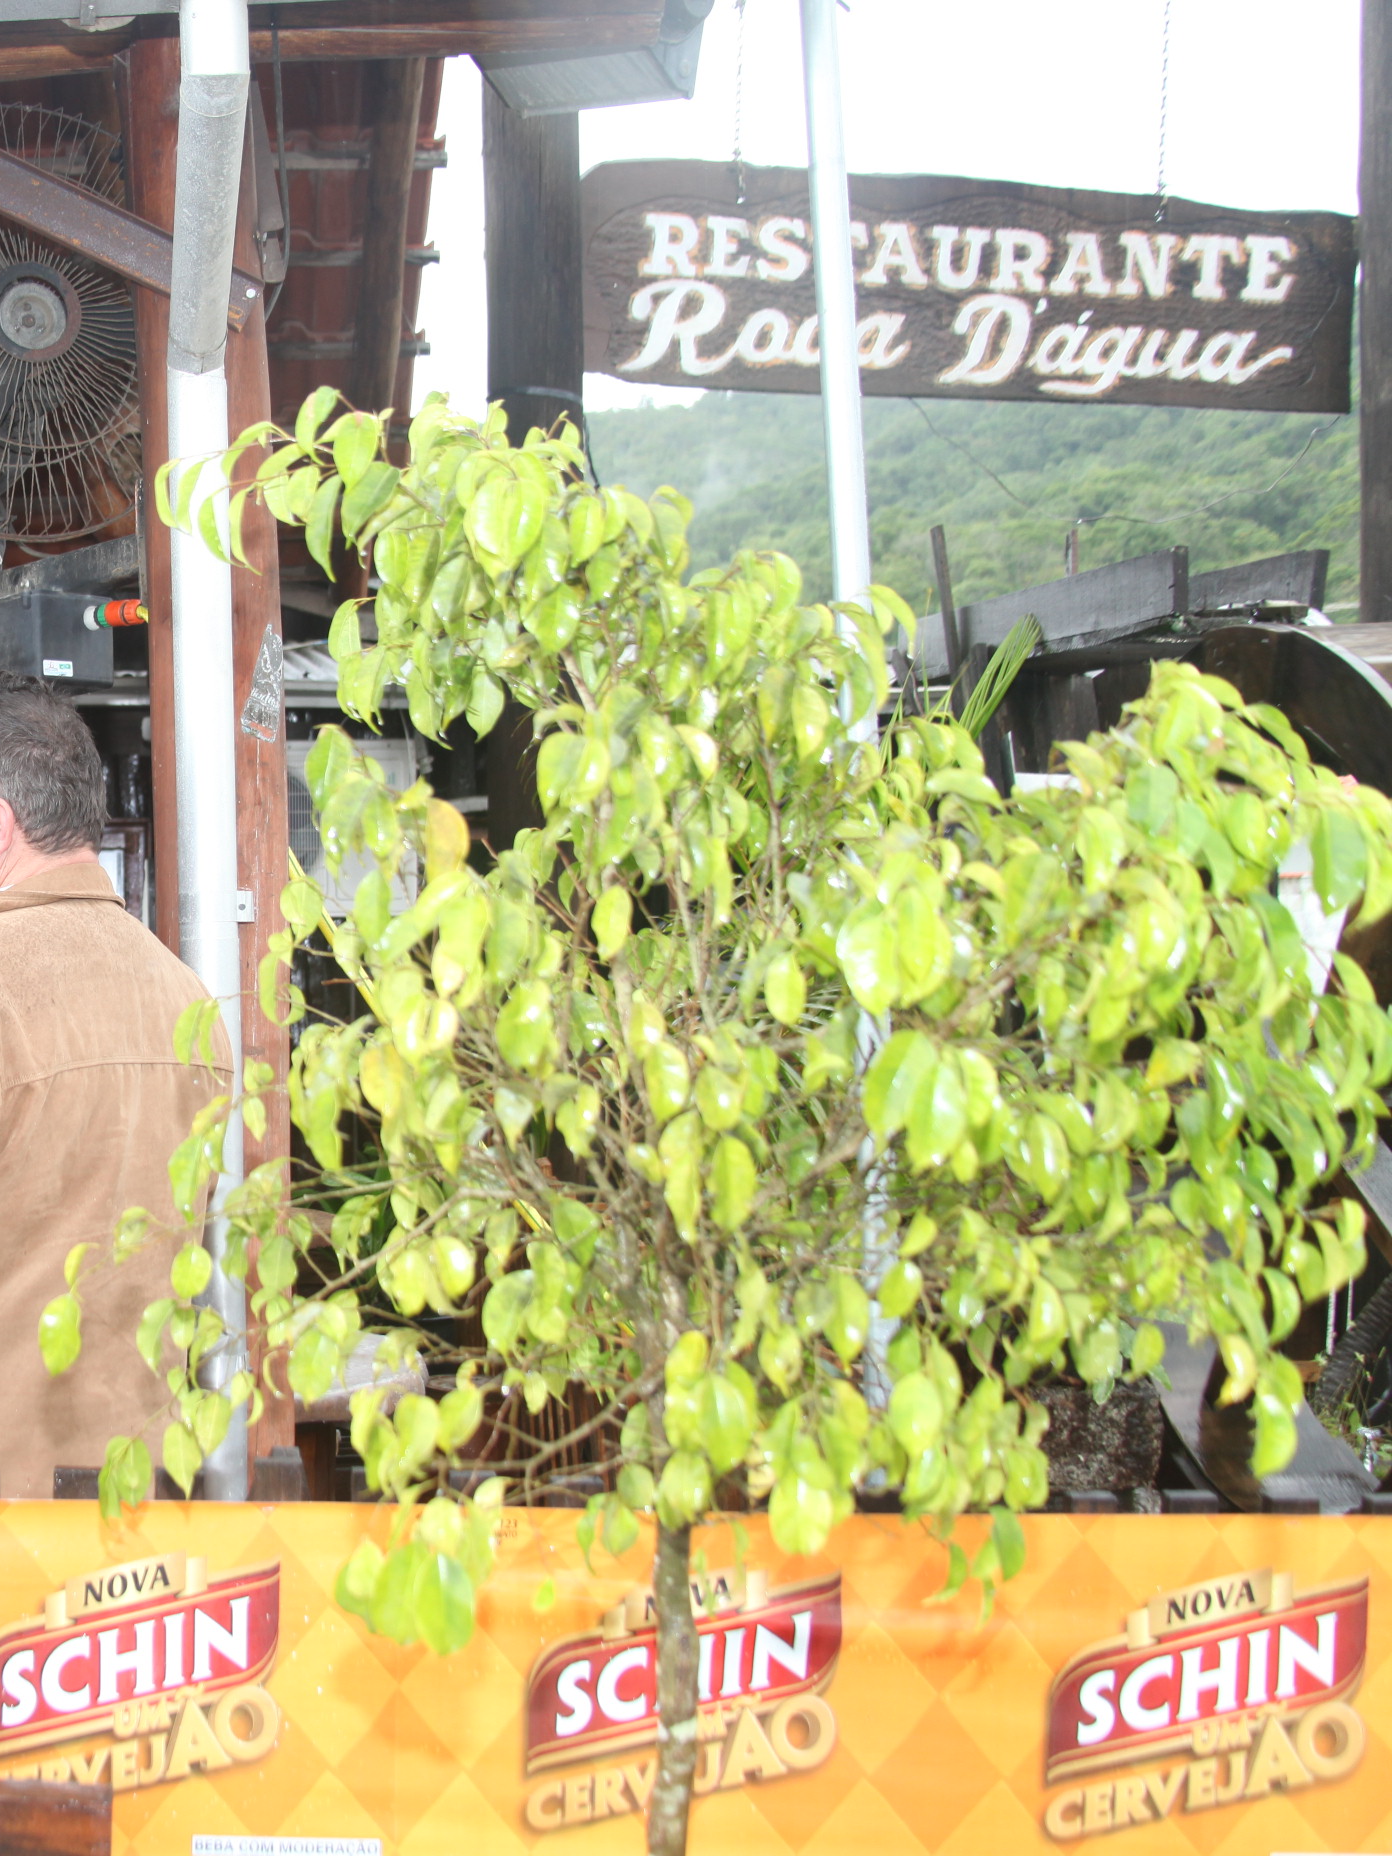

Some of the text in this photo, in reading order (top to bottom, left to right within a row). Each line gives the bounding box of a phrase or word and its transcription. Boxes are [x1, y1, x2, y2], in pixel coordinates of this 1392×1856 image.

[641, 212, 1296, 302] RESAURANTE
[83, 1562, 172, 1604] NOVA
[1165, 1579, 1256, 1625] NOVA
[1, 1596, 250, 1728] SCHIN
[1077, 1611, 1337, 1746] SCHIN
[1045, 1700, 1365, 1840] CERVEJÃO
[238, 1840, 274, 1854] COM
